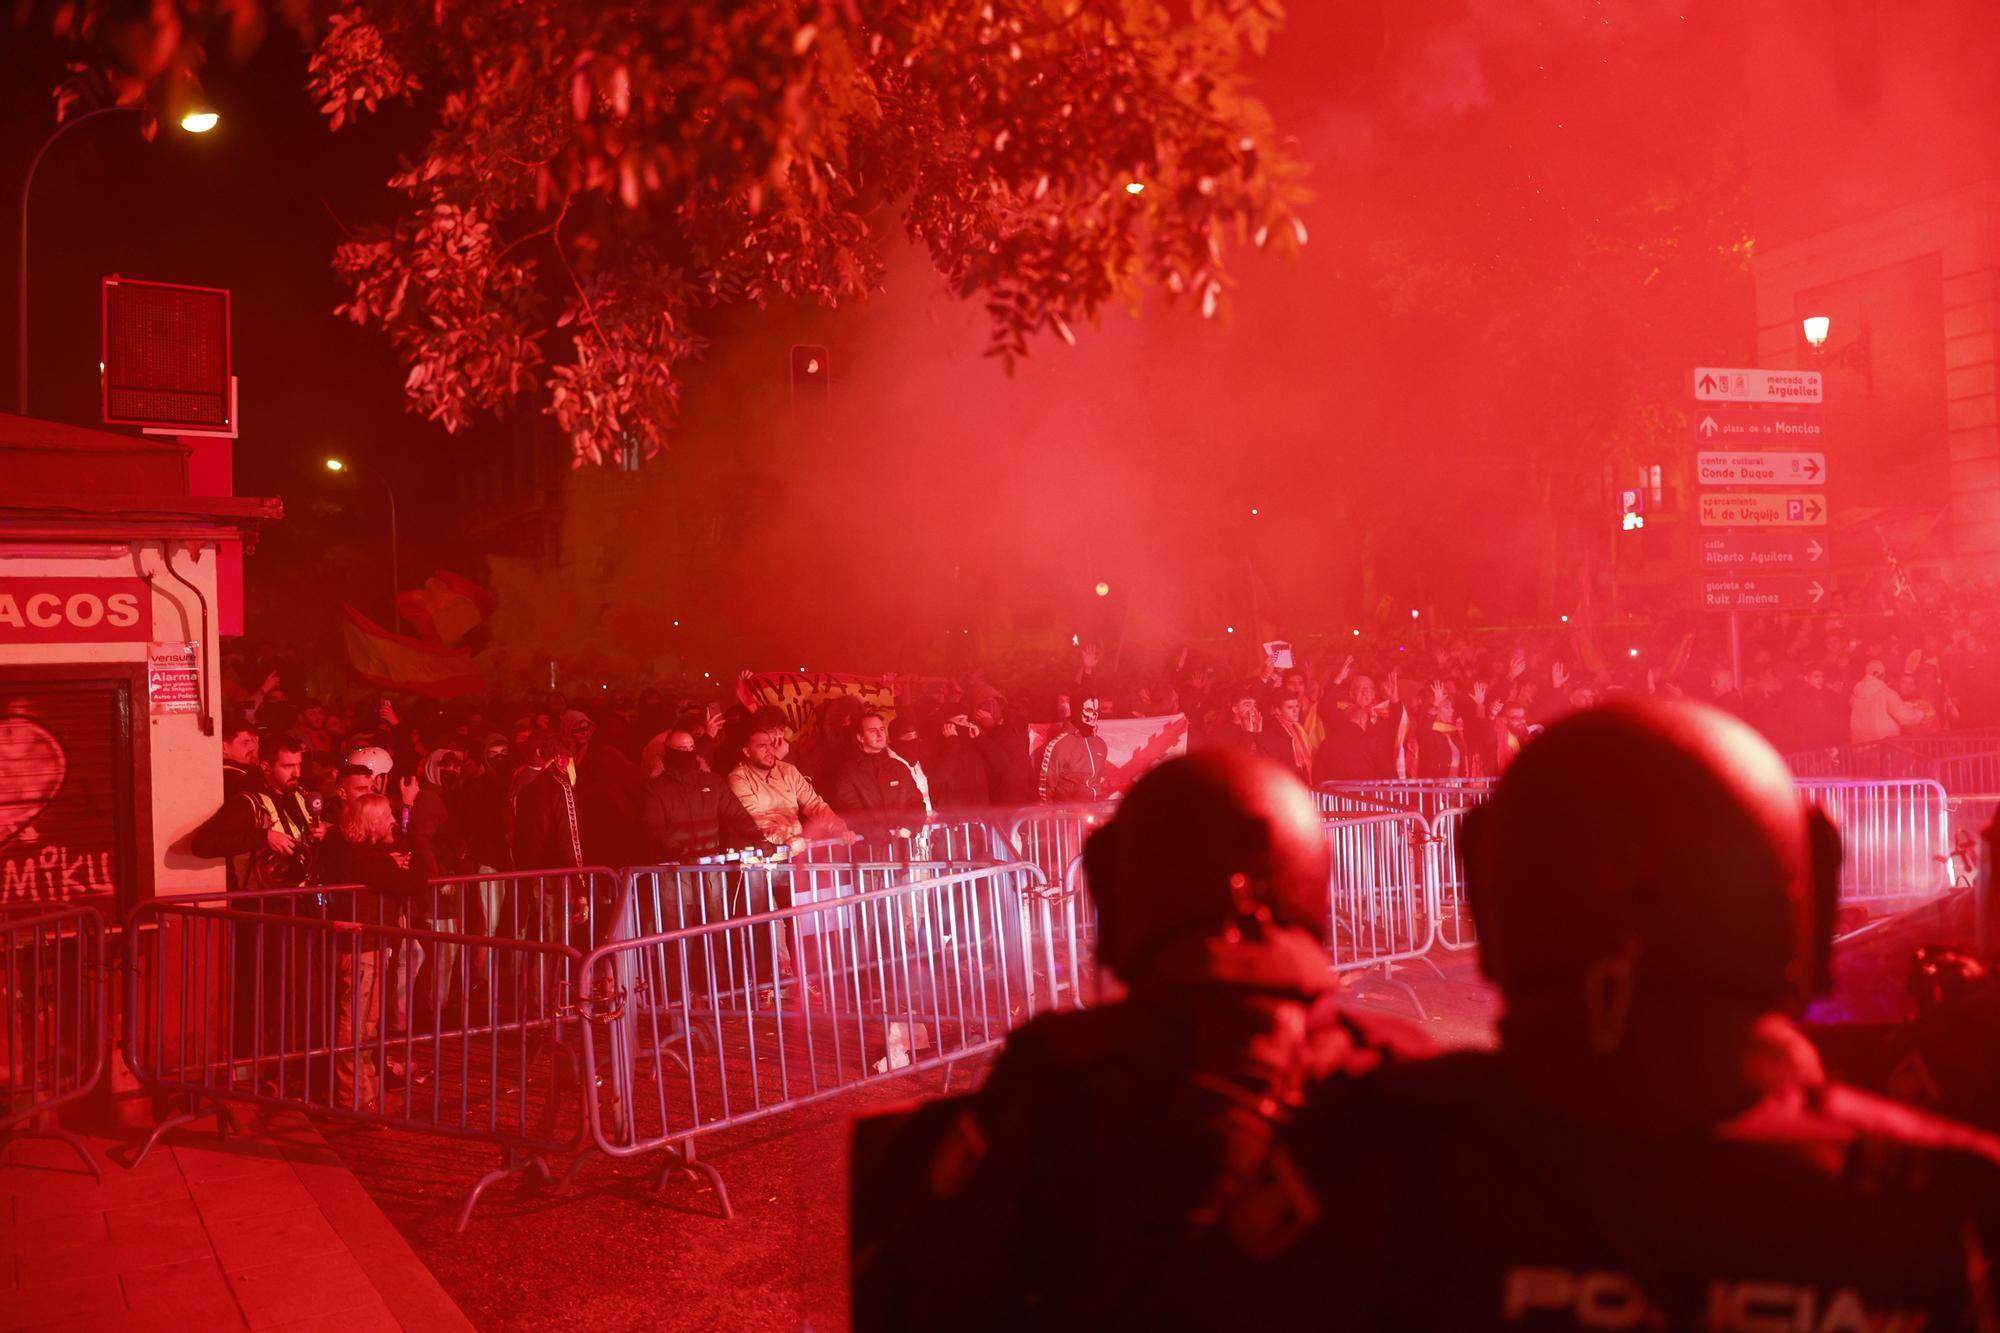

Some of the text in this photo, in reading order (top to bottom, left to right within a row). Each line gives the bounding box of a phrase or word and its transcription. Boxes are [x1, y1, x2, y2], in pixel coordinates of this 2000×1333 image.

[1767, 376, 1818, 385] mercado de
[1768, 385, 1818, 397] Argüelles
[1723, 422, 1820, 434] plaza de la Moncloa
[1701, 457, 1764, 465] centro cultural
[1702, 468, 1774, 480] Conde Duque
[1704, 508, 1716, 520] M.
[1722, 509, 1734, 520] de
[1740, 508, 1779, 522] Urquijo
[1705, 541, 1725, 549] calle
[1706, 551, 1793, 563] Alberto Aguilera
[1706, 582, 1755, 592] glorieta de
[1706, 592, 1779, 605] Ruiz Jiménez
[152, 672, 197, 682] Alarma
[1504, 1265, 1872, 1333] POICIA
